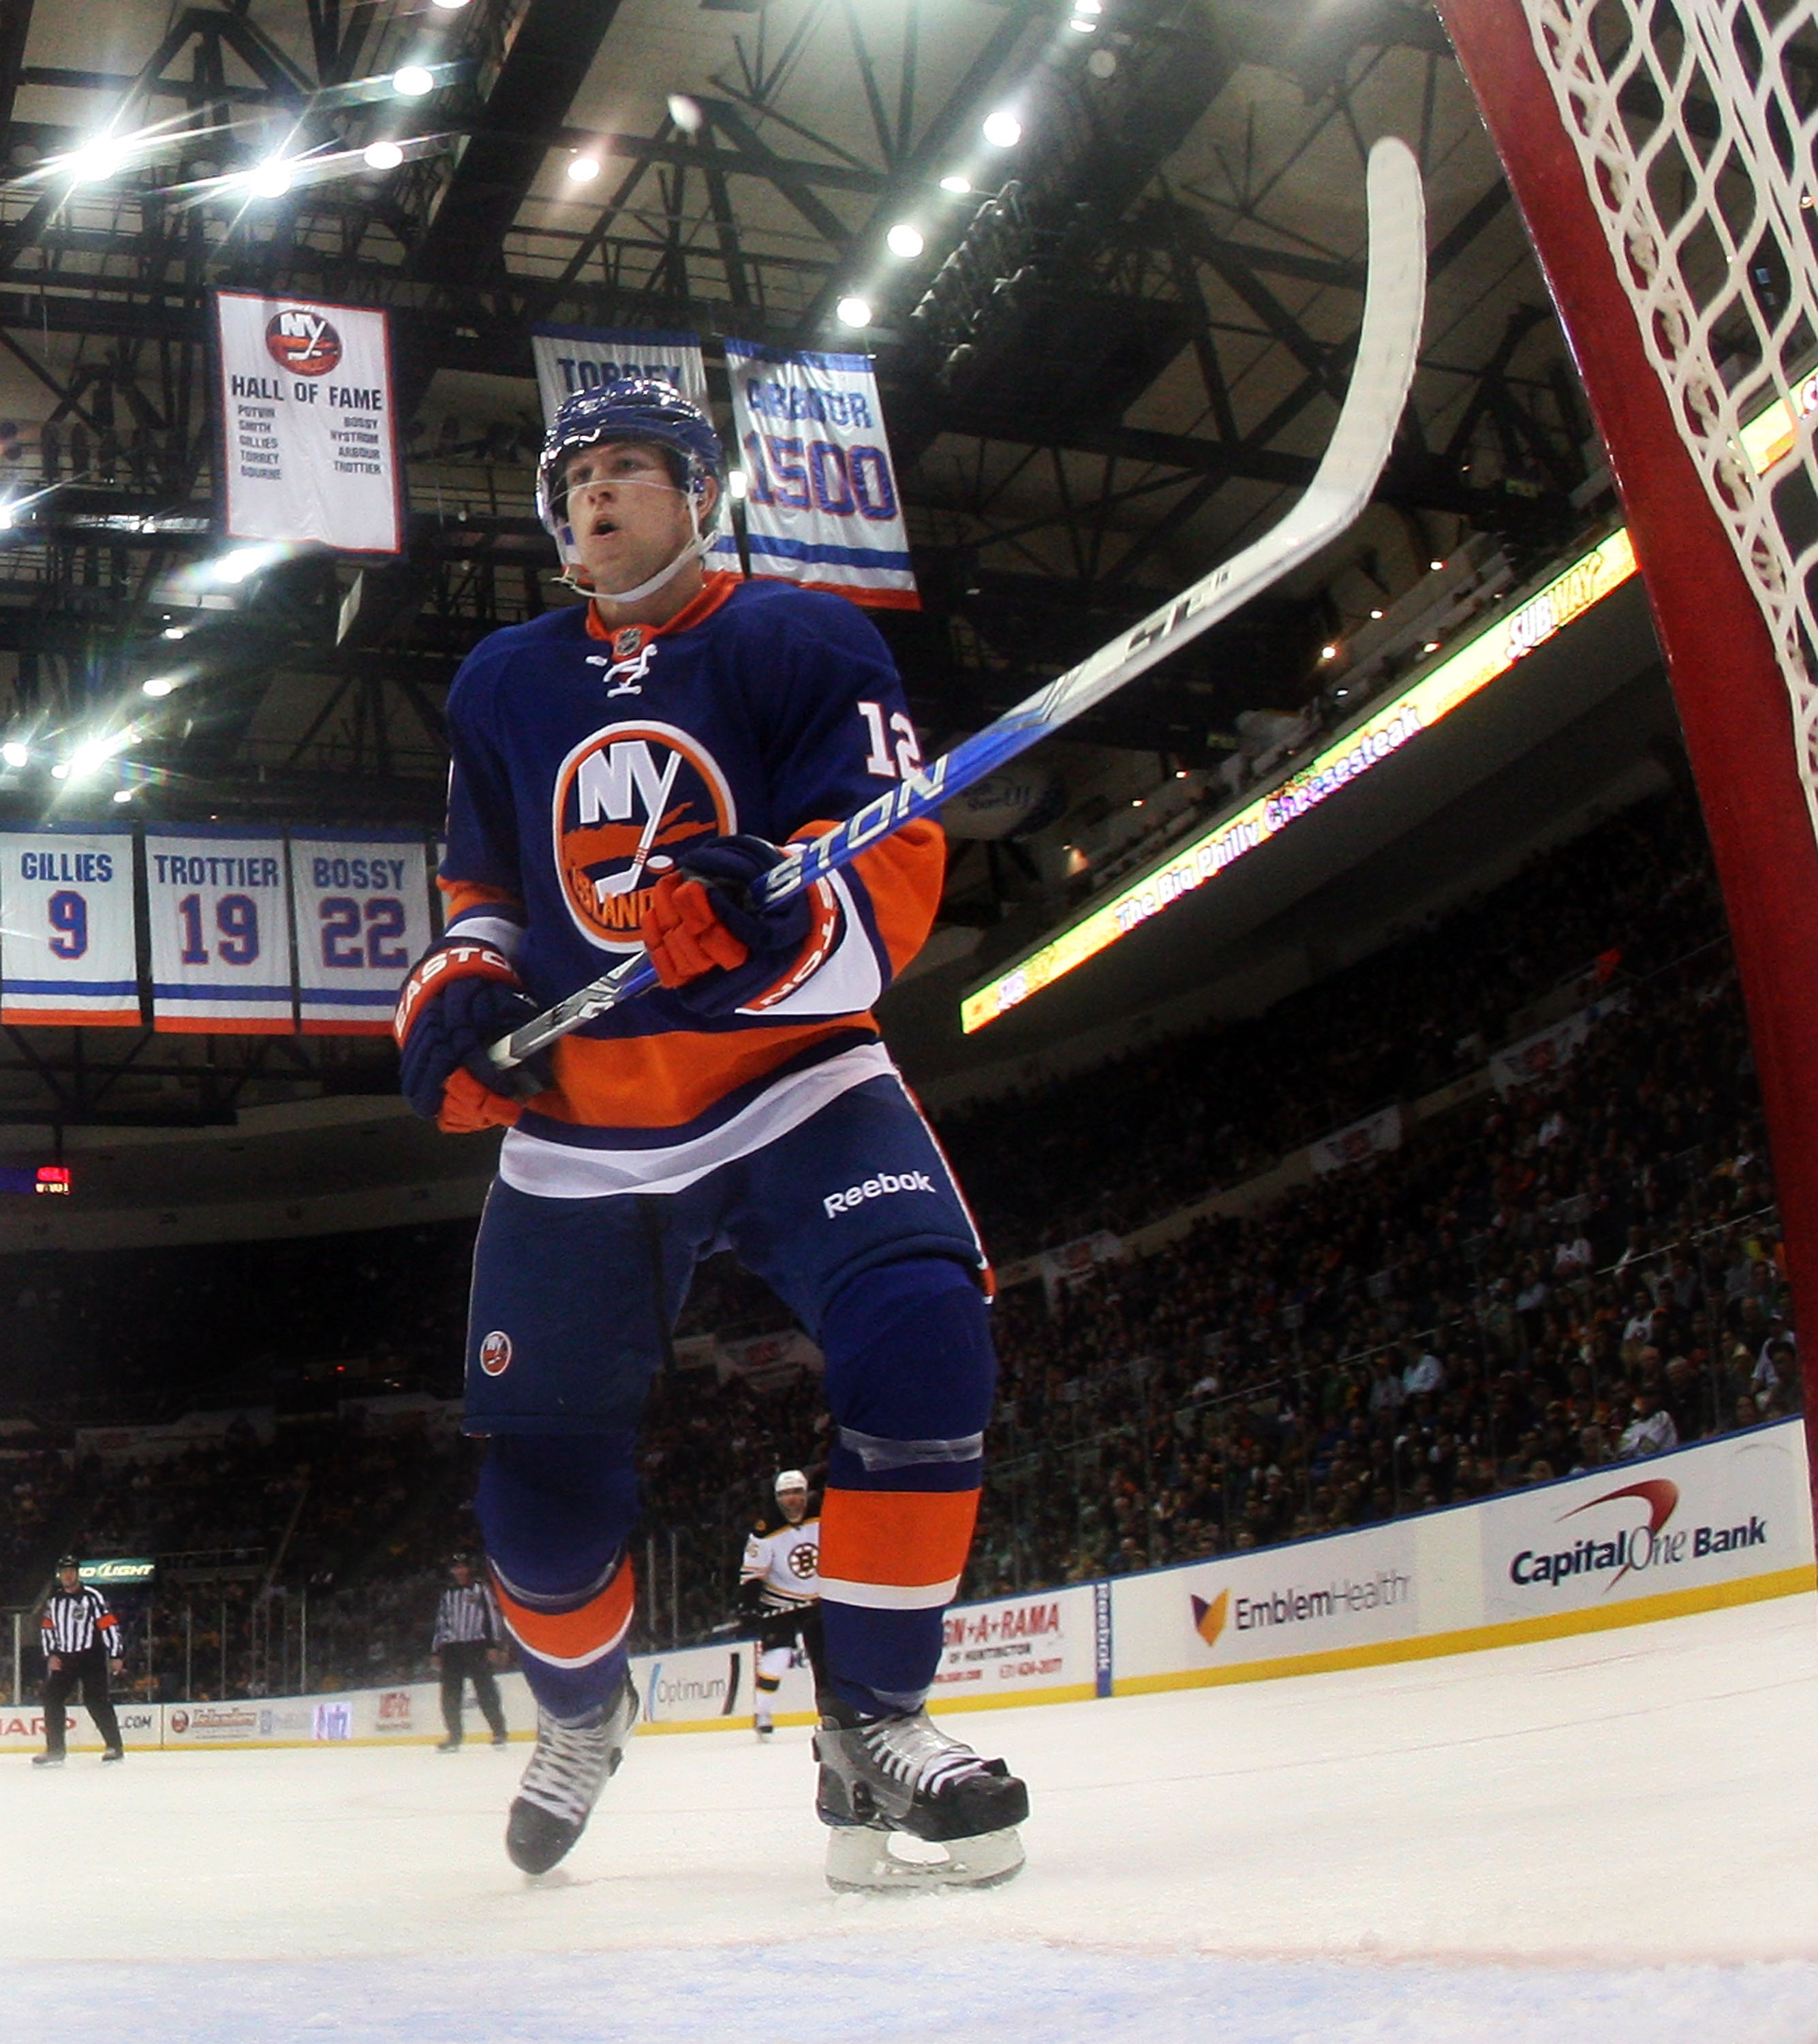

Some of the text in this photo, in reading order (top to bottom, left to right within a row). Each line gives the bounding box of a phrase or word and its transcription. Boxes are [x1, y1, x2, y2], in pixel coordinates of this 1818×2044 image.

[232, 375, 382, 410] HALL OF FAME
[238, 420, 271, 433] SMITH
[239, 435, 278, 449] GILLIES
[344, 416, 378, 429] BOSSY
[335, 461, 381, 475] TROTTIER
[743, 431, 898, 521] 1500
[1505, 553, 1603, 660] SUBWAY
[857, 702, 923, 780] 12
[578, 739, 682, 835] NY
[764, 753, 949, 903] STON
[21, 852, 112, 882] GILLIES
[154, 854, 279, 887] TROTTIER
[313, 857, 405, 890] BOSSY
[48, 891, 87, 959] 9
[179, 893, 260, 965] 19
[320, 897, 409, 968] 22
[1113, 897, 1156, 932] The
[395, 947, 517, 1038] EASTO
[822, 1171, 936, 1219] Reebok
[1693, 1515, 1768, 1558] Bank
[102, 1564, 154, 1576] LIGHT
[1235, 1569, 1411, 1630] EmblemHealth
[657, 1678, 726, 1705] Optimum
